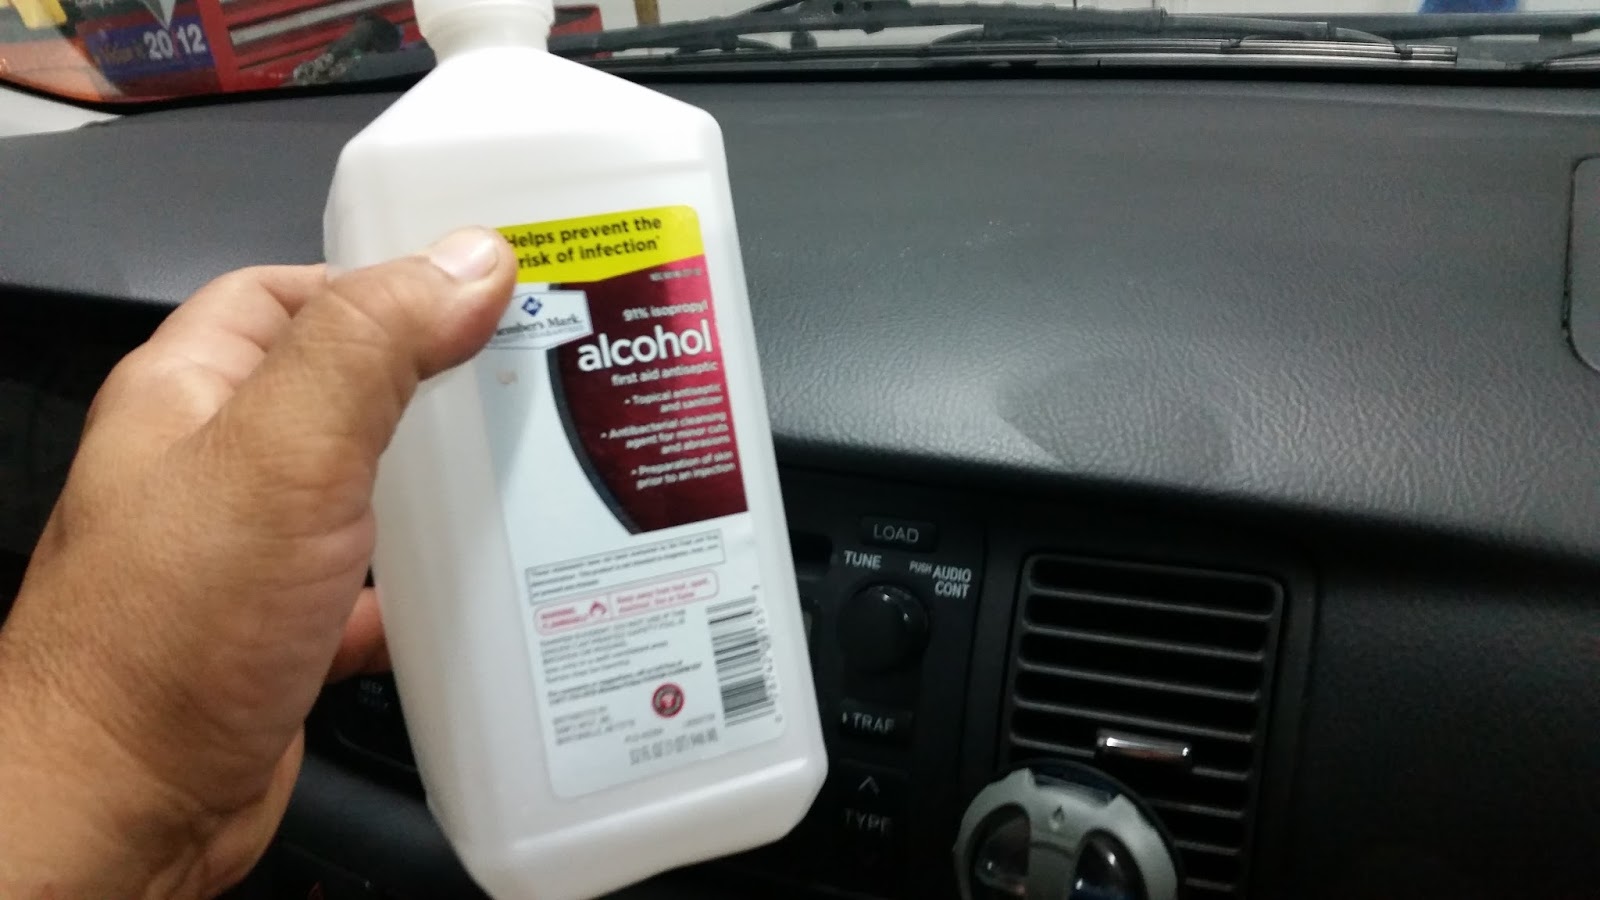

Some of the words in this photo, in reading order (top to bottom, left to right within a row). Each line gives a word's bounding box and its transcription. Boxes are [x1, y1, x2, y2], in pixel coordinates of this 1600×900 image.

[506, 231, 555, 248] Helps
[560, 219, 629, 243] prevent
[634, 215, 662, 231] the
[518, 252, 551, 268] risk
[556, 248, 573, 263] of
[622, 306, 650, 321] 91%
[650, 299, 708, 318] isopropyl
[577, 318, 713, 372] alcohol
[611, 372, 638, 386] first
[639, 368, 660, 381] aid
[661, 361, 718, 379] antiseptic
[632, 389, 673, 405] Topical
[672, 383, 722, 399] antiseptic
[660, 401, 682, 413] and
[682, 395, 723, 409] sanitizer
[609, 419, 679, 439] Antibacterial
[679, 411, 727, 427] cleansing
[625, 435, 658, 450] agent
[658, 431, 675, 442] for
[675, 427, 706, 439] minor
[707, 423, 729, 434] cuts
[660, 442, 682, 455] and
[683, 435, 730, 450] abrasions
[638, 456, 701, 476] Preparation
[701, 452, 713, 464] of
[713, 450, 734, 463] skin
[636, 476, 664, 490] prior
[664, 472, 678, 483] to
[678, 471, 693, 481] an
[693, 463, 736, 478] injection
[873, 523, 919, 543] LOAD
[844, 549, 882, 570] TUNE
[909, 560, 933, 574] PUSH
[932, 565, 972, 583] AUDIO
[935, 580, 970, 599] CONT
